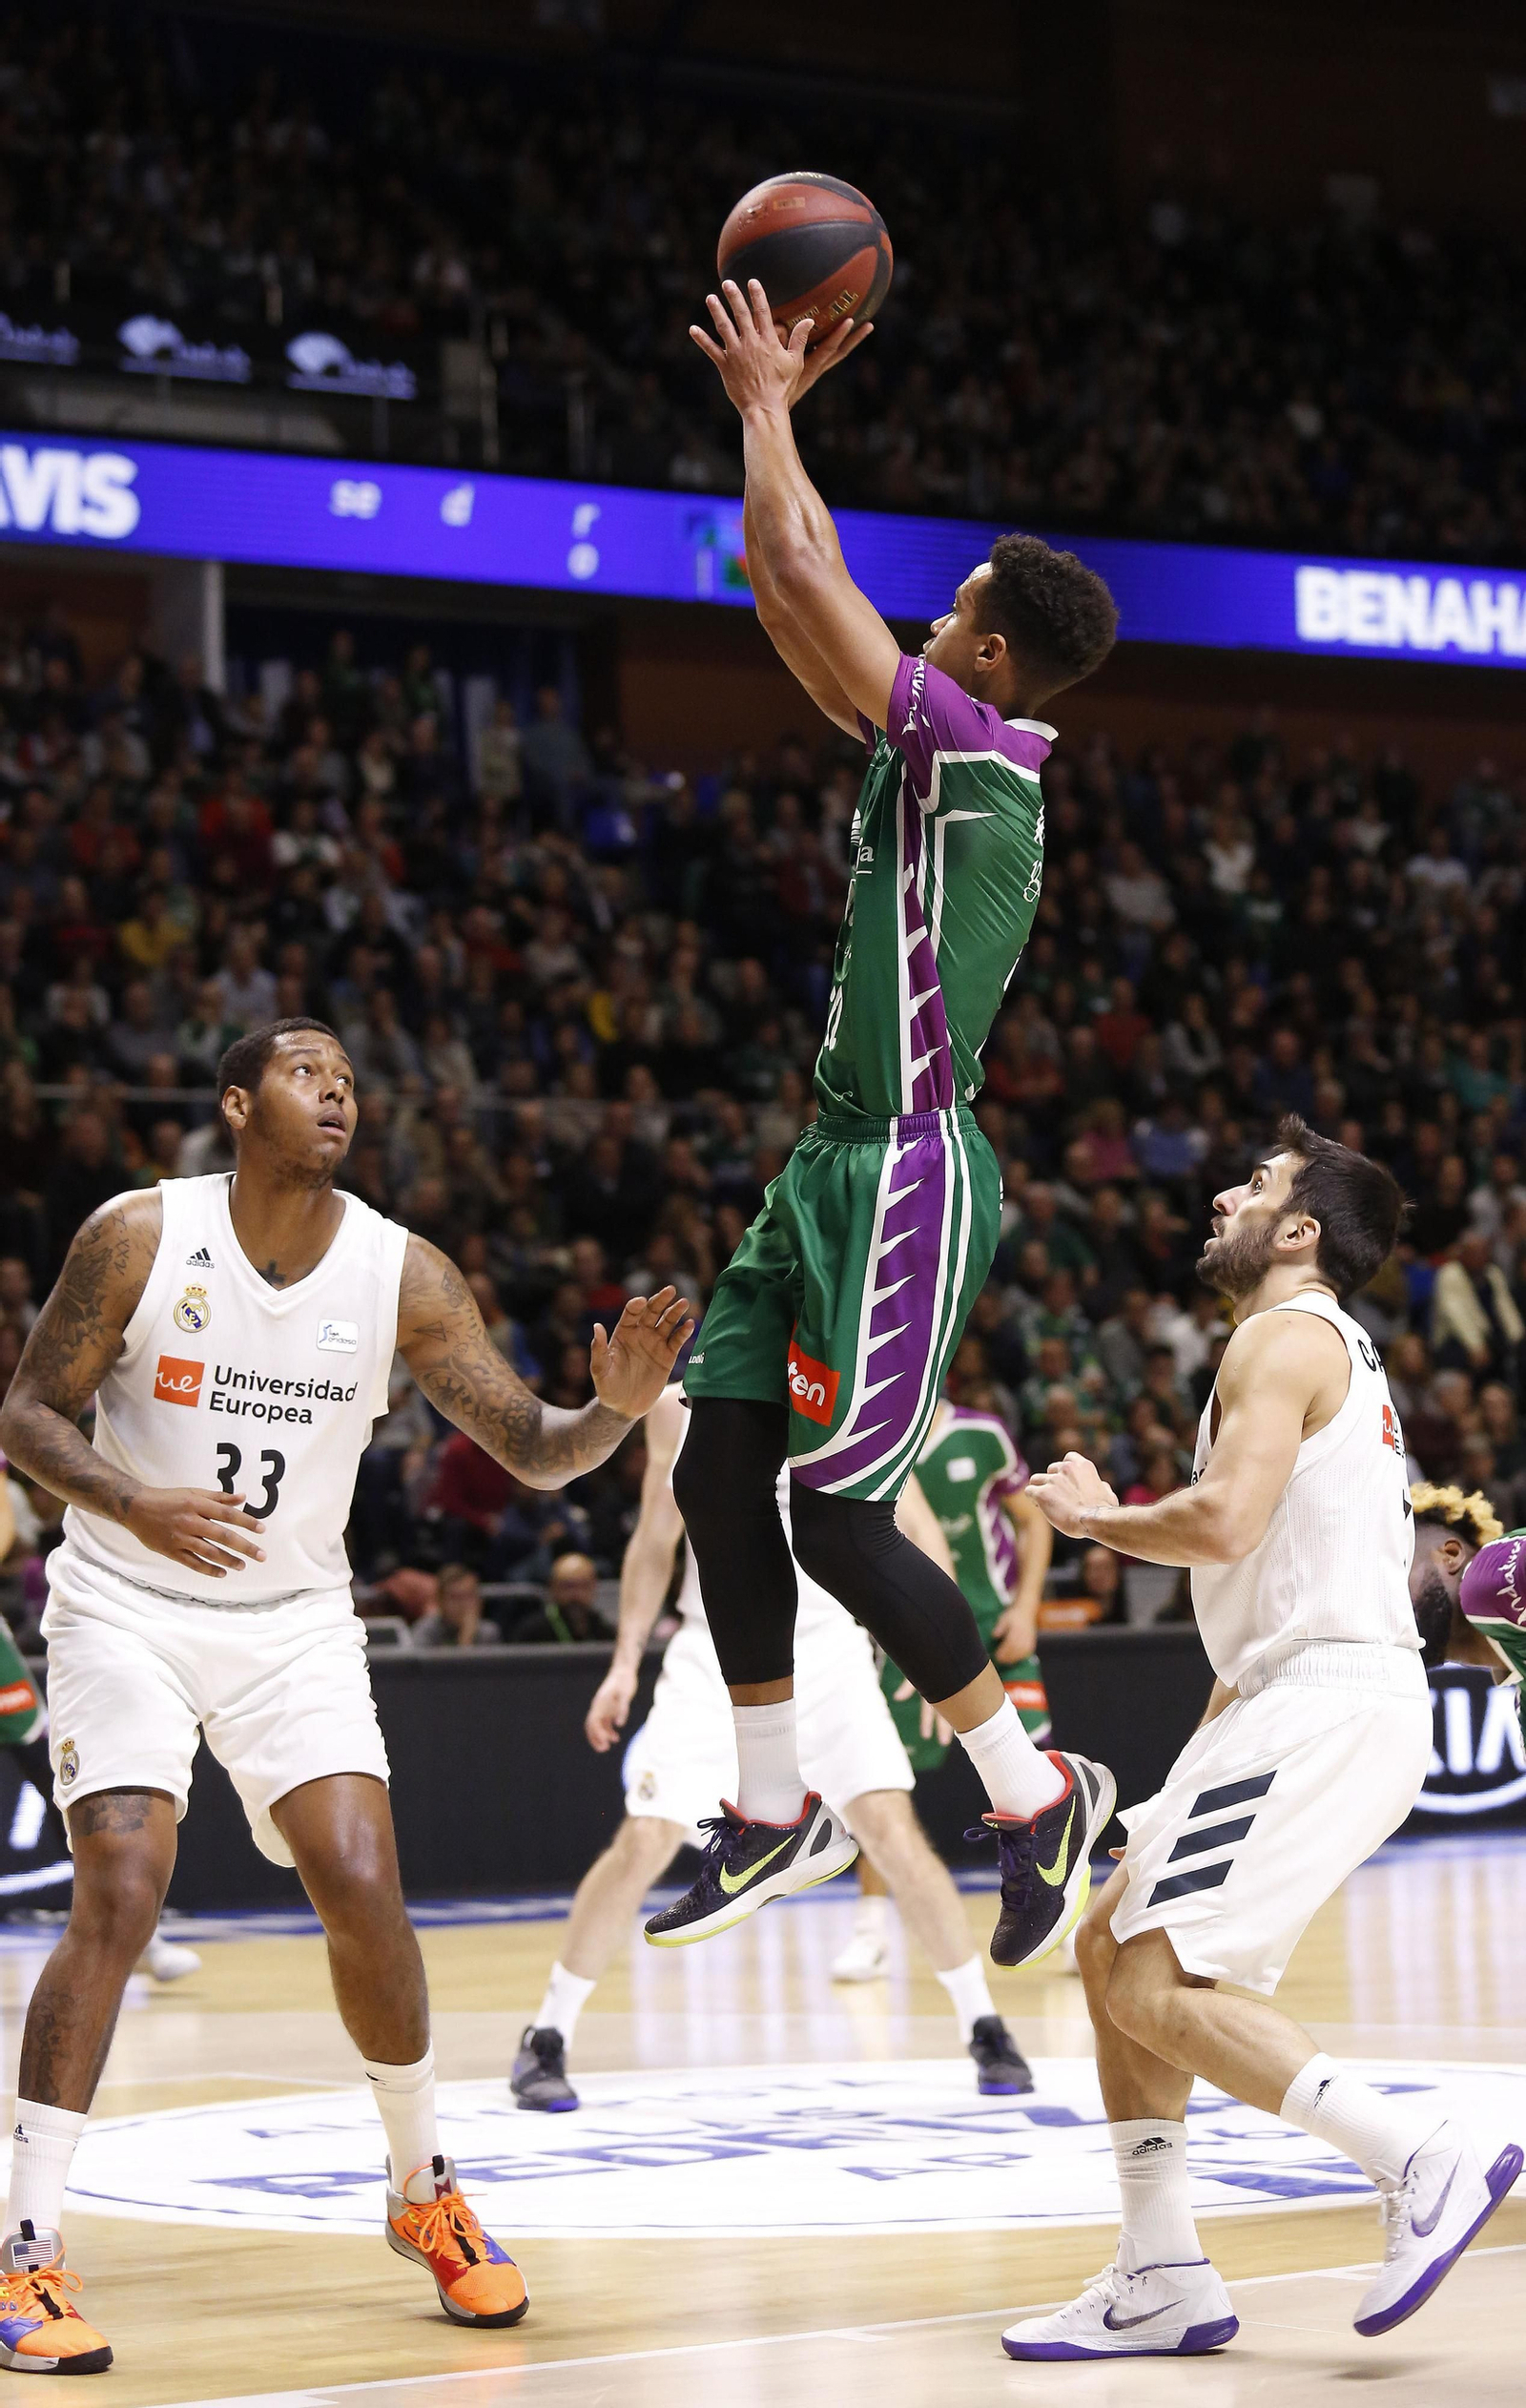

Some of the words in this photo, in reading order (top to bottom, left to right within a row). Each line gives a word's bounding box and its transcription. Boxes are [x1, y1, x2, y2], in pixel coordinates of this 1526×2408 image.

[0, 445, 141, 540] VIS
[1294, 565, 1526, 659] BENAH
[186, 1258, 216, 1269] adidas
[214, 1364, 358, 1402] Universidad
[209, 1390, 313, 1424] Europea
[217, 1443, 286, 1520] 33
[1132, 2142, 1173, 2156] adidas
